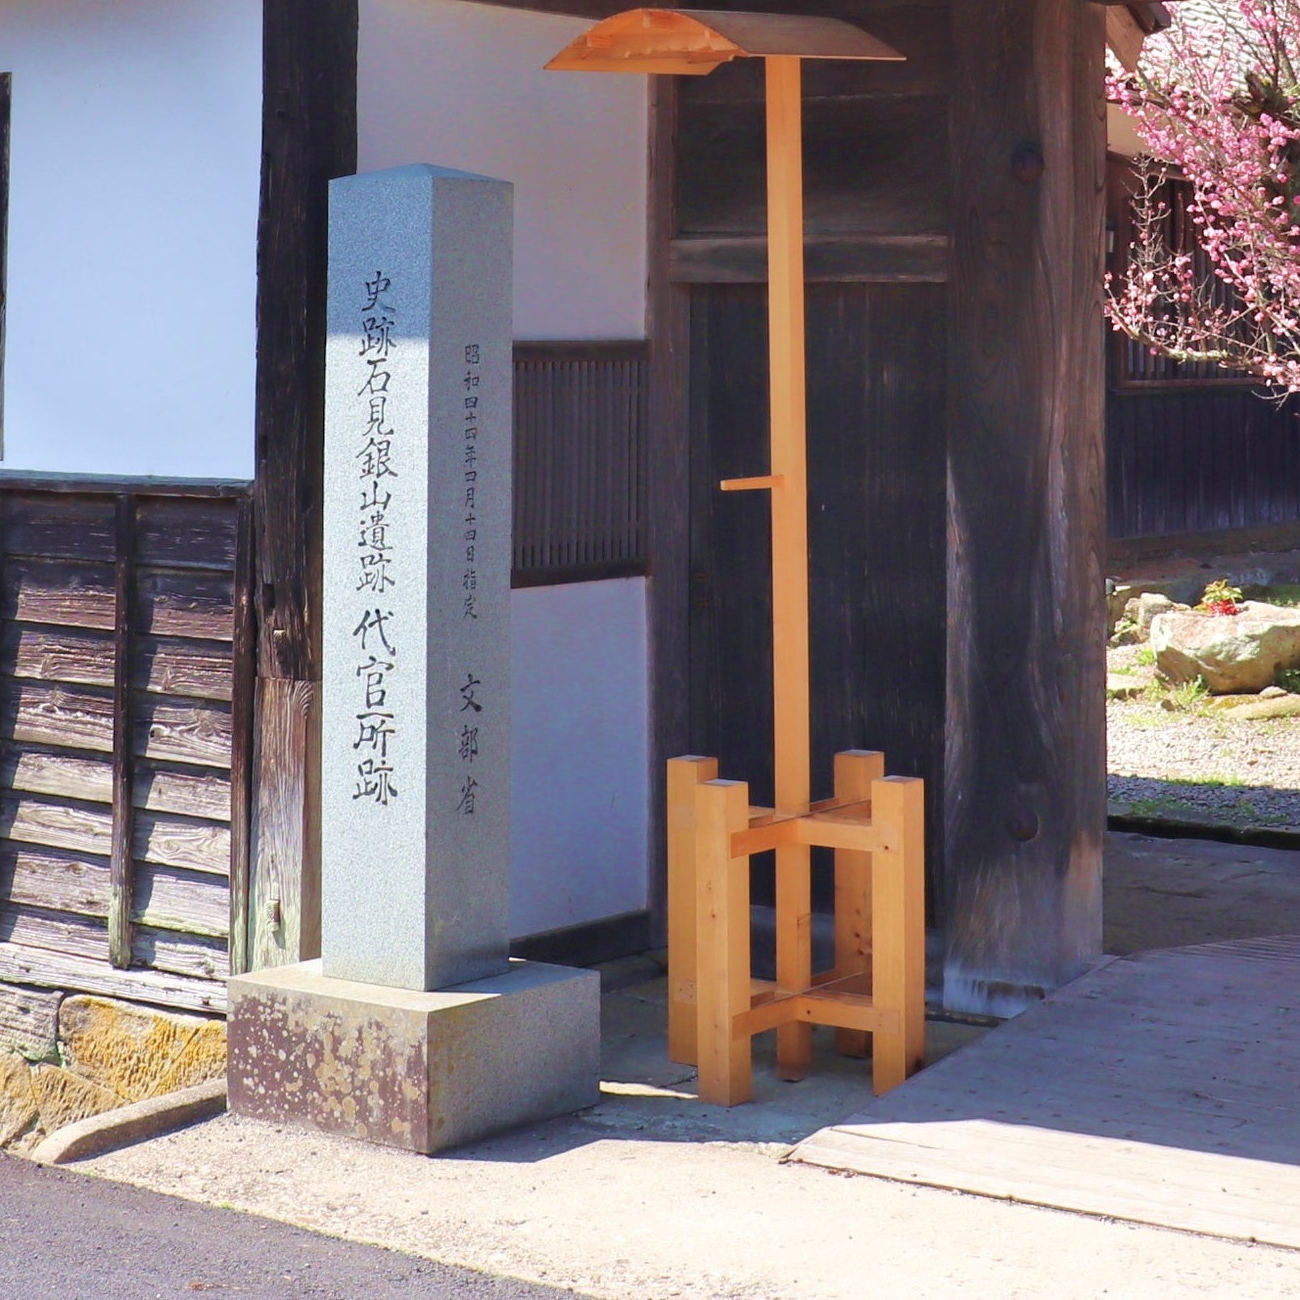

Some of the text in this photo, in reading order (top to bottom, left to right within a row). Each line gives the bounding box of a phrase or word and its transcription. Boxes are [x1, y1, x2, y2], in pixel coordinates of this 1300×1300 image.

[352, 270, 398, 806] 史跡石見銀山遺跡 代官所跡
[456, 344, 482, 814] 昭和四十四年四月十四日指定 文部省
